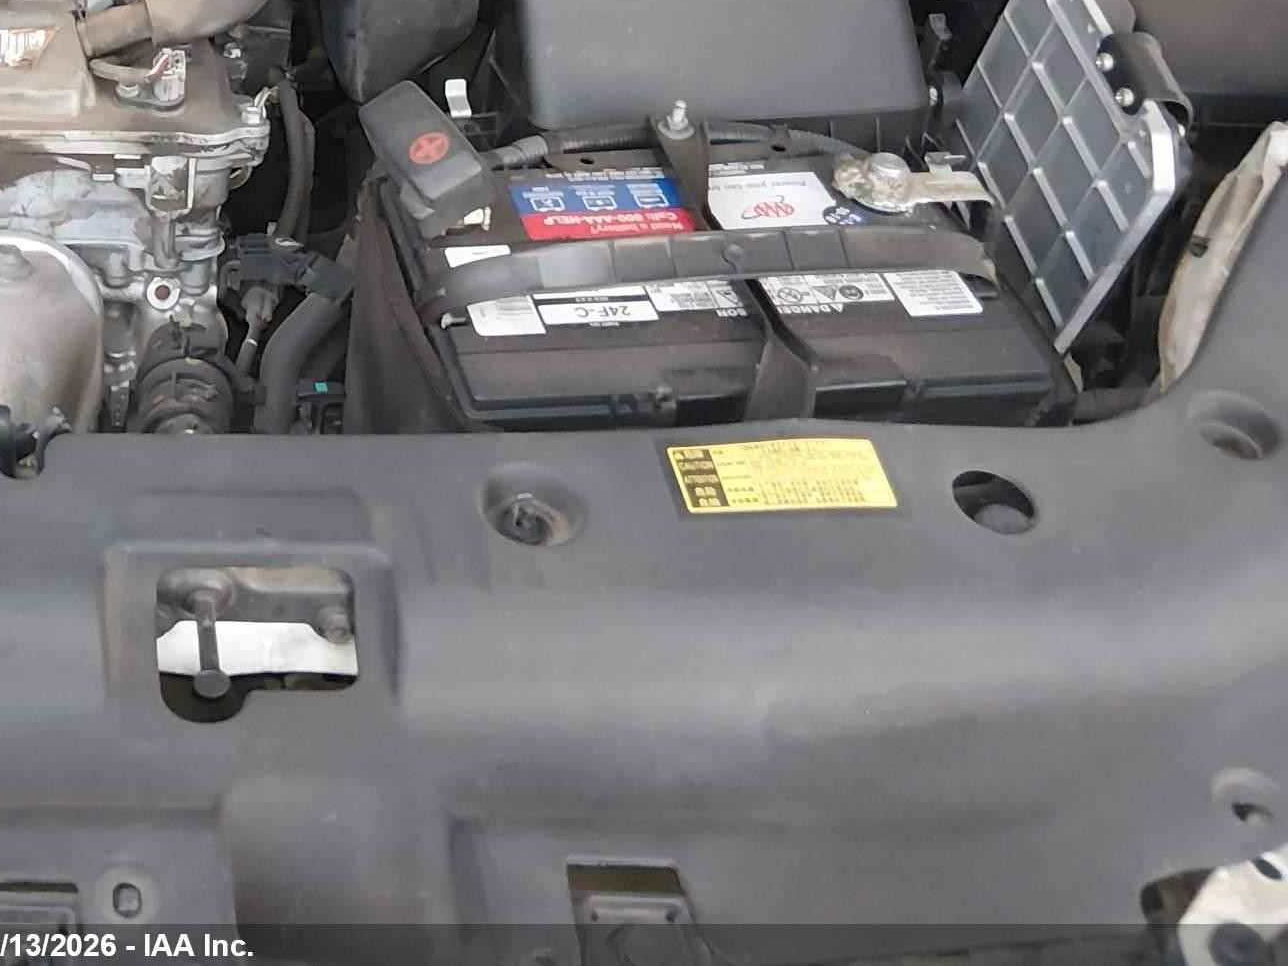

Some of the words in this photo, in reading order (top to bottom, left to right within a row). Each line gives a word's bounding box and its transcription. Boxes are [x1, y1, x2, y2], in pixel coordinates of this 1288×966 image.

[645, 211, 677, 221] Call:
[753, 202, 795, 218] AAA
[543, 213, 643, 226] 800-AAA-HELP
[652, 221, 684, 231] Need
[574, 304, 632, 318] 24F-C
